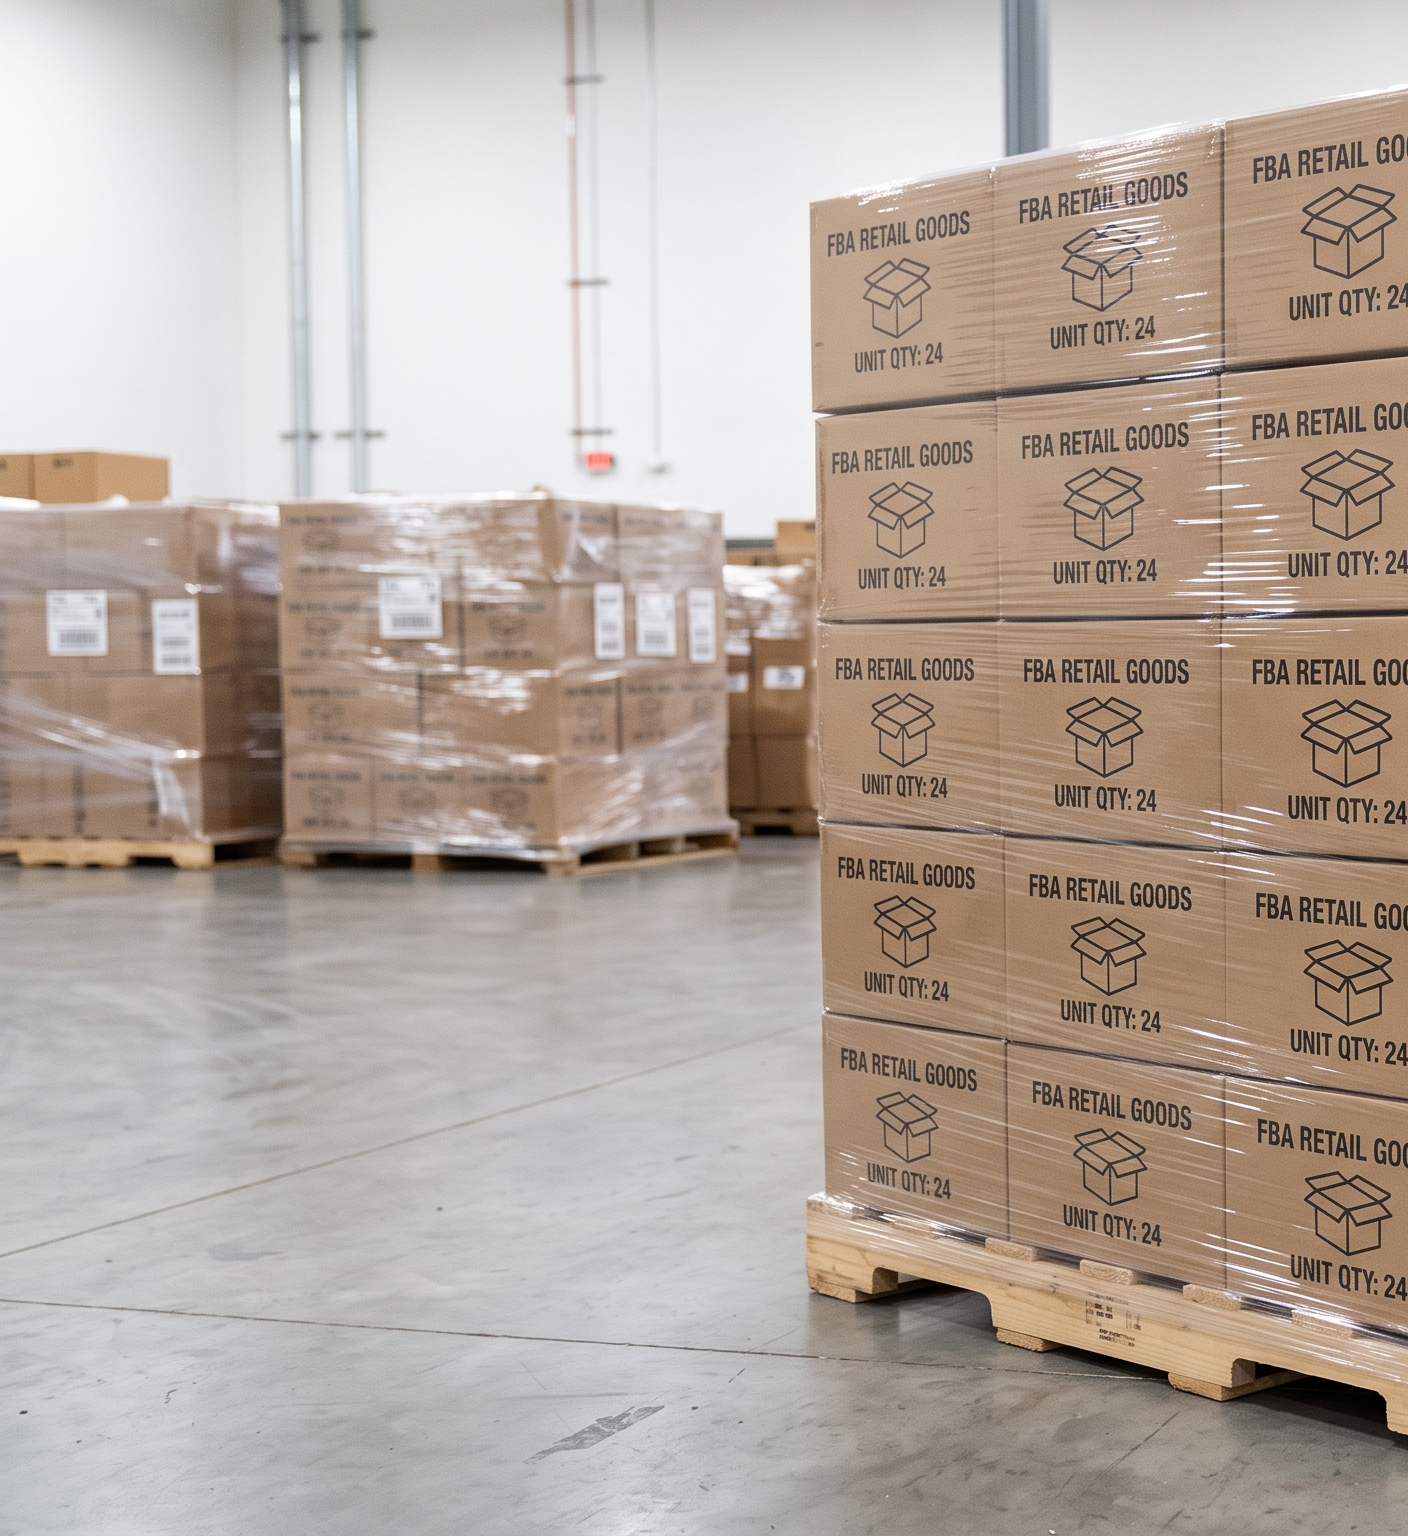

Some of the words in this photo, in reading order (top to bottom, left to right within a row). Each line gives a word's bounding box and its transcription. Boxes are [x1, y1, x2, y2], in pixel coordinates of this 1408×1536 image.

[1253, 152, 1292, 185] FBA
[1298, 140, 1369, 177] RETAIL
[828, 230, 855, 257] FBA
[860, 221, 911, 251] RETAIL
[915, 210, 970, 242] GOODS
[1289, 291, 1333, 321] UNIT
[1339, 286, 1381, 317] QTY:
[1022, 433, 1055, 460] FBA
[1060, 427, 1120, 457] RETAIL
[1125, 421, 1190, 452] GOODS
[1252, 412, 1290, 441] FBA
[1296, 405, 1367, 437] RETAIL
[832, 450, 860, 474] FBA
[864, 445, 915, 472] RETAIL
[919, 439, 973, 467] GOODS
[1053, 560, 1091, 585] UNIT
[1095, 559, 1132, 585] QTY:
[1136, 558, 1158, 582] 24
[1288, 552, 1331, 578] UNIT
[1336, 550, 1379, 579] QTY:
[835, 658, 863, 681] FBA
[867, 658, 917, 681] RETAIL
[921, 657, 975, 682] GOODS
[1023, 658, 1057, 683] FBA
[1061, 658, 1121, 684] RETAIL
[1126, 658, 1190, 685] GOODS
[1252, 659, 1291, 685] FBA
[1296, 658, 1367, 686] RETAIL
[861, 773, 893, 796] UNIT
[896, 774, 927, 798] QTY:
[930, 776, 948, 799] 24
[1054, 783, 1092, 809] UNIT
[1096, 785, 1132, 812] QTY:
[1136, 788, 1157, 813] 24
[1287, 794, 1331, 821] UNIT
[1336, 796, 1378, 825] QTY:
[1383, 799, 1408, 825] 24
[838, 856, 866, 880] FBA
[869, 858, 919, 885] RETAIL
[922, 863, 976, 890] GOODS
[1029, 873, 1062, 900] FBA
[1066, 876, 1125, 906] RETAIL
[1130, 881, 1193, 912] GOODS
[1255, 892, 1294, 922] FBA
[1299, 896, 1368, 928] RETAIL
[1060, 998, 1098, 1025] UNIT
[1101, 1003, 1136, 1029] QTY:
[1140, 1009, 1162, 1034] 24
[1290, 1028, 1333, 1057] UNIT
[1338, 1034, 1379, 1062] QTY:
[1384, 1040, 1408, 1067] 24
[1032, 1080, 1065, 1109] FBA
[1069, 1086, 1126, 1120] RETAIL
[1130, 1097, 1192, 1131] GOODS
[1257, 1118, 1295, 1149] FBA
[1300, 1125, 1367, 1162] RETAIL
[1290, 1254, 1333, 1285] UNIT
[1338, 1264, 1378, 1295] QTY:
[1383, 1274, 1408, 1302] 24
